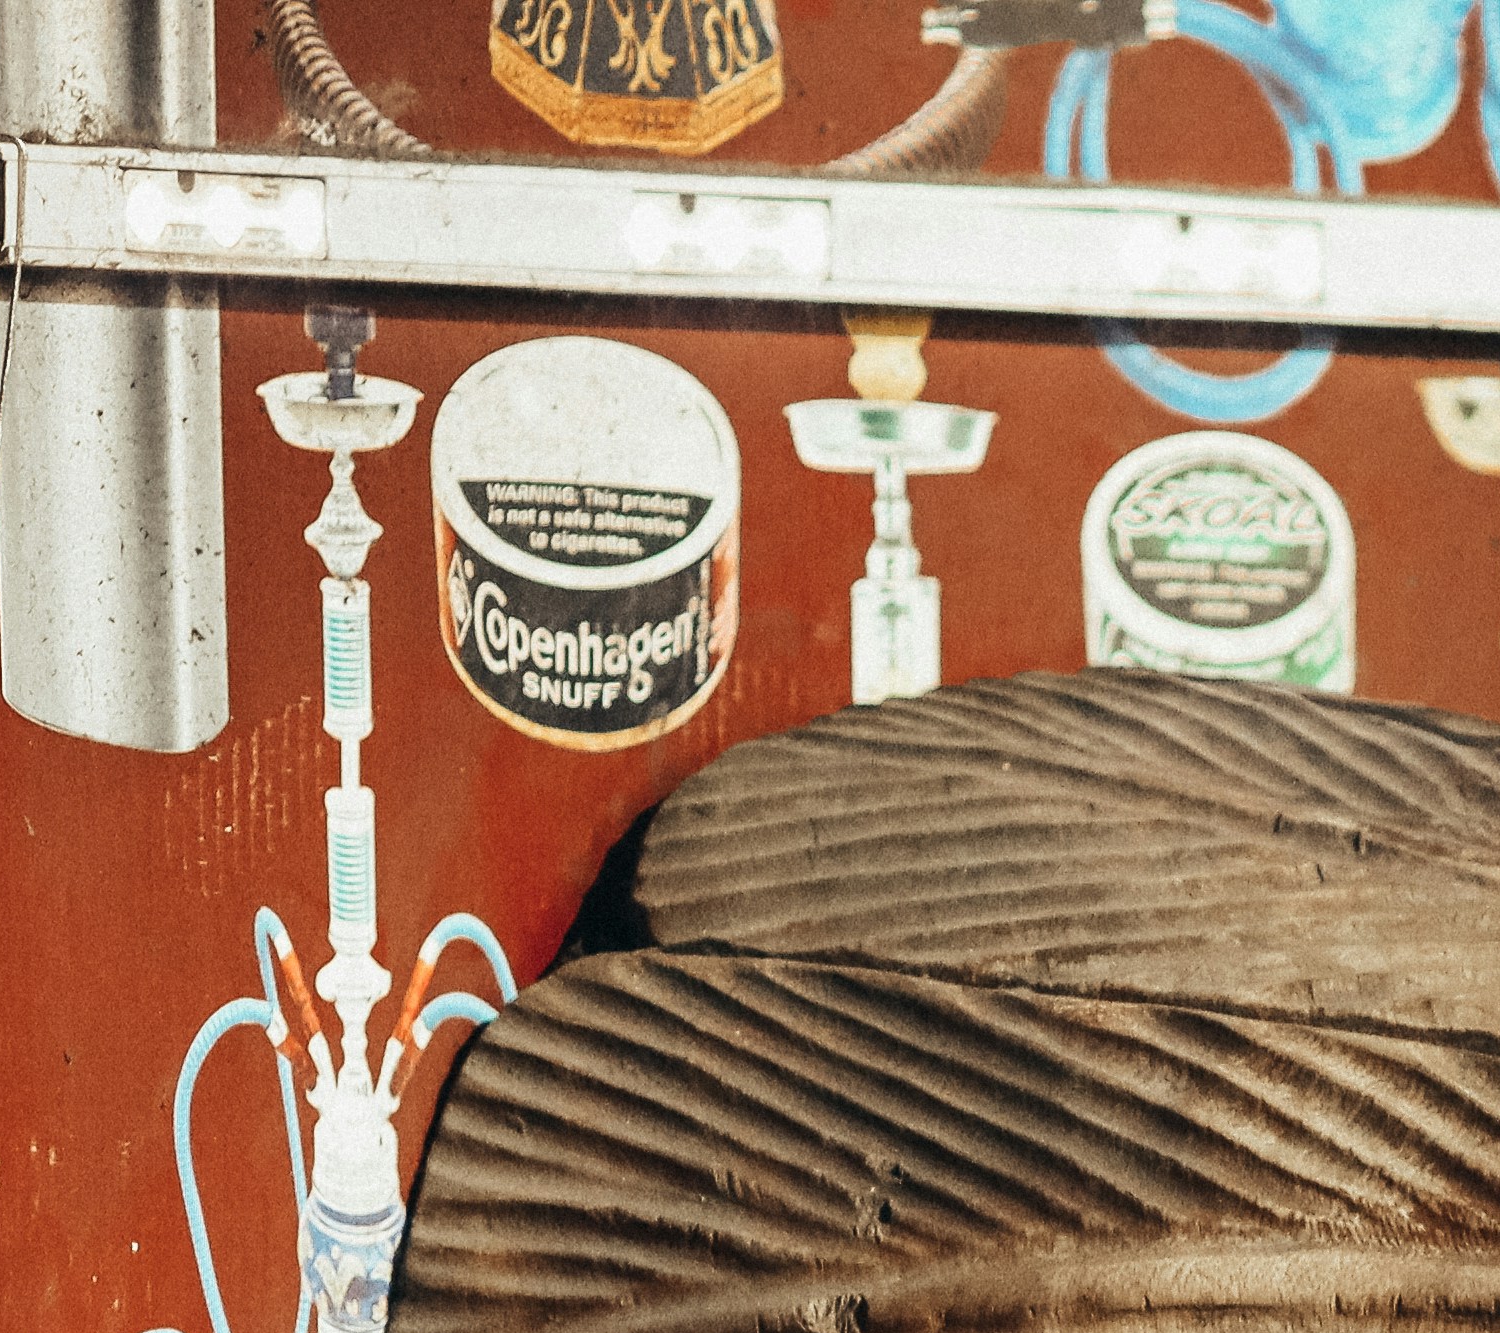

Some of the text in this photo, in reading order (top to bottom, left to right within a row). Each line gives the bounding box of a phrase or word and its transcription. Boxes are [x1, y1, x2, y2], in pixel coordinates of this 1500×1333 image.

[582, 487, 618, 509] This
[621, 494, 688, 516] product
[1114, 488, 1324, 533] SKOAL
[488, 505, 687, 537] is not a safe alternative
[529, 530, 548, 549] to
[474, 581, 692, 702] Copenhagen
[522, 671, 621, 709] SNUFF
